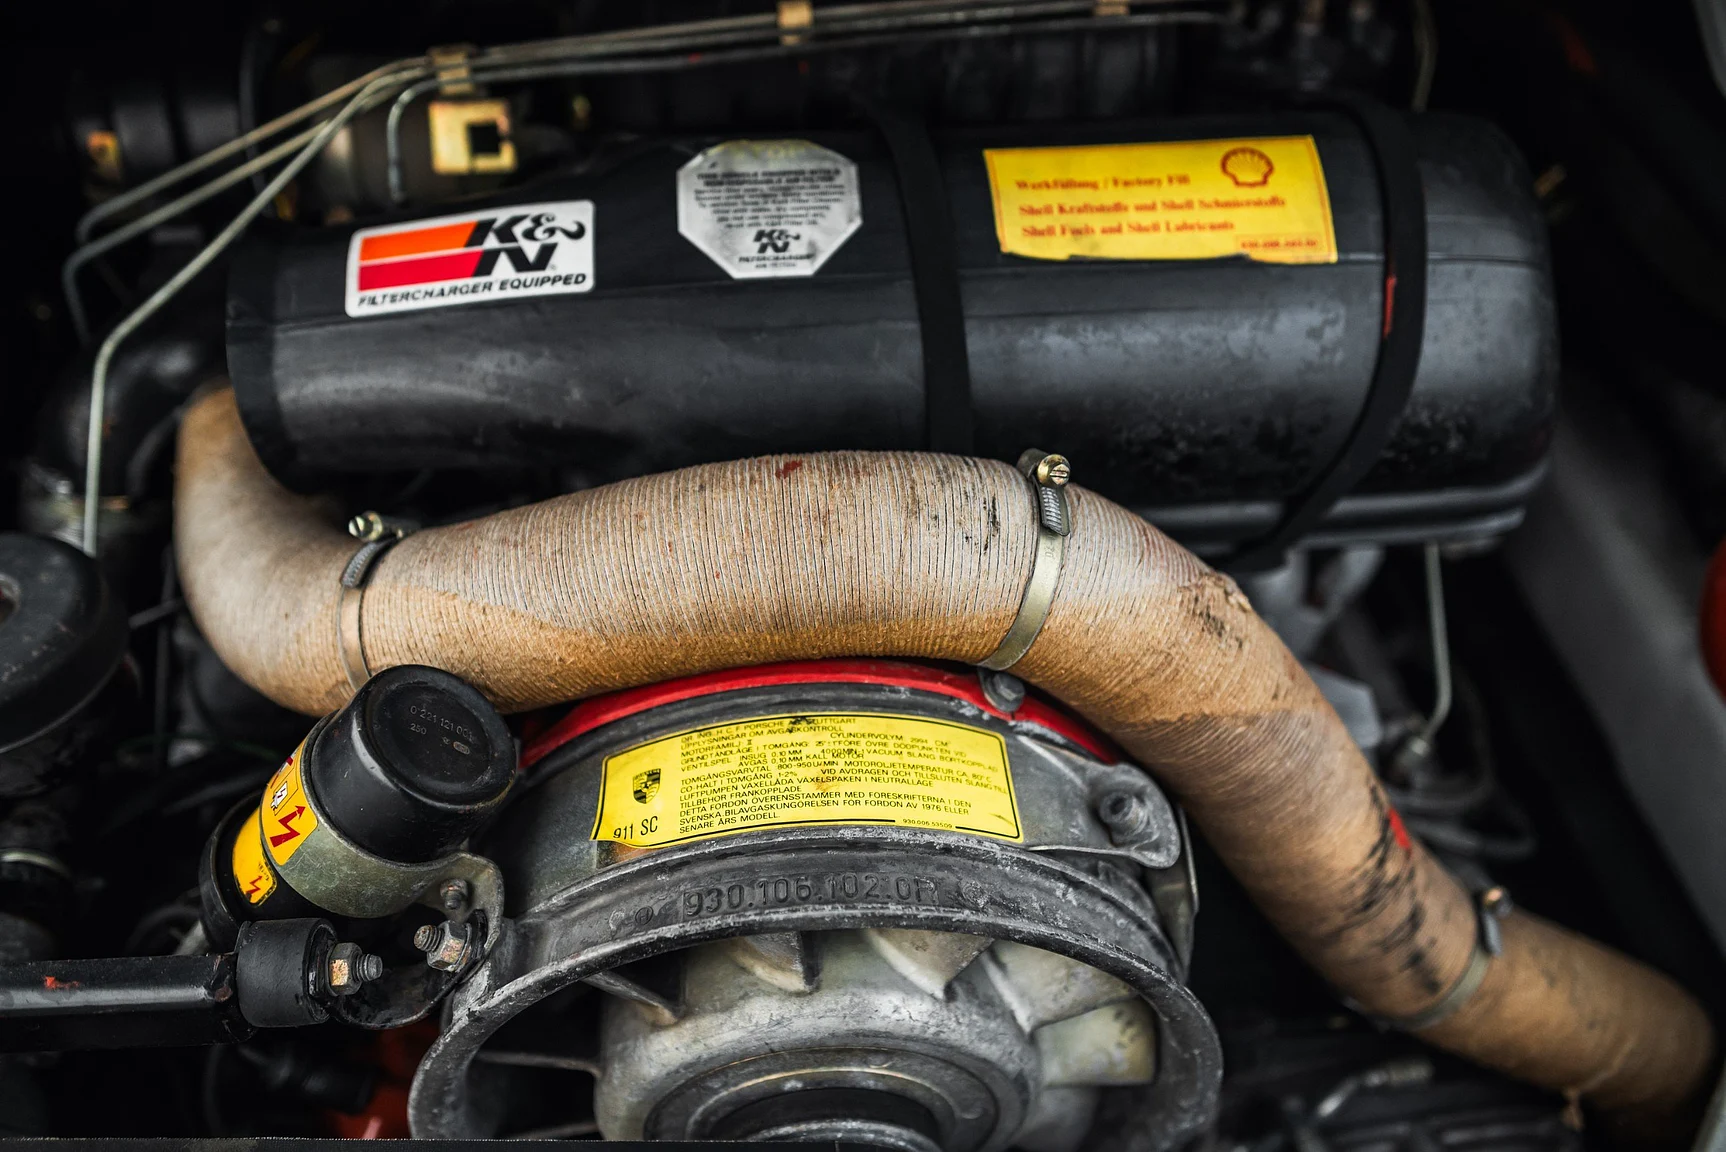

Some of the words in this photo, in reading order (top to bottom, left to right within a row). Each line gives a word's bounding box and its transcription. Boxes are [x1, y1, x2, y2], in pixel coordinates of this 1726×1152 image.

[1112, 176, 1162, 189] Factory
[1167, 174, 1191, 186] Fill
[1019, 203, 1054, 216] Shell
[1134, 200, 1157, 212] und
[1162, 198, 1194, 211] Shell
[1022, 224, 1056, 238] Shell
[1061, 224, 1095, 237] Fuels
[1101, 222, 1122, 235] and
[1128, 220, 1160, 233] Shell
[463, 212, 586, 278] K&N
[358, 281, 493, 307] FILTERCHARGER
[499, 273, 587, 291] EQUIPPED
[419, 709, 437, 723] 221
[440, 717, 454, 731] 121
[744, 721, 784, 729] PORSCHE
[680, 733, 746, 750] UPPLYSNINGAR
[738, 758, 768, 767] AVGAS
[739, 752, 766, 761] INSUG
[867, 748, 903, 756] VACUUM
[907, 752, 936, 760] SLANG
[726, 773, 772, 784] TOMGÅNG
[915, 772, 962, 783] TILLSLUTEN
[966, 779, 992, 790] SLANG
[994, 785, 1007, 794] TILL
[680, 786, 738, 801] LUFTPUMPEN
[680, 807, 707, 817] DETTA
[710, 799, 748, 811] FORDON
[954, 799, 971, 808] DEN
[865, 800, 903, 808] FORDON
[922, 803, 942, 811] 1976
[944, 806, 969, 815] ELLER
[613, 824, 633, 840] 911
[640, 816, 658, 835] SC
[680, 821, 714, 834] SENARE
[718, 816, 737, 826] ÅRS
